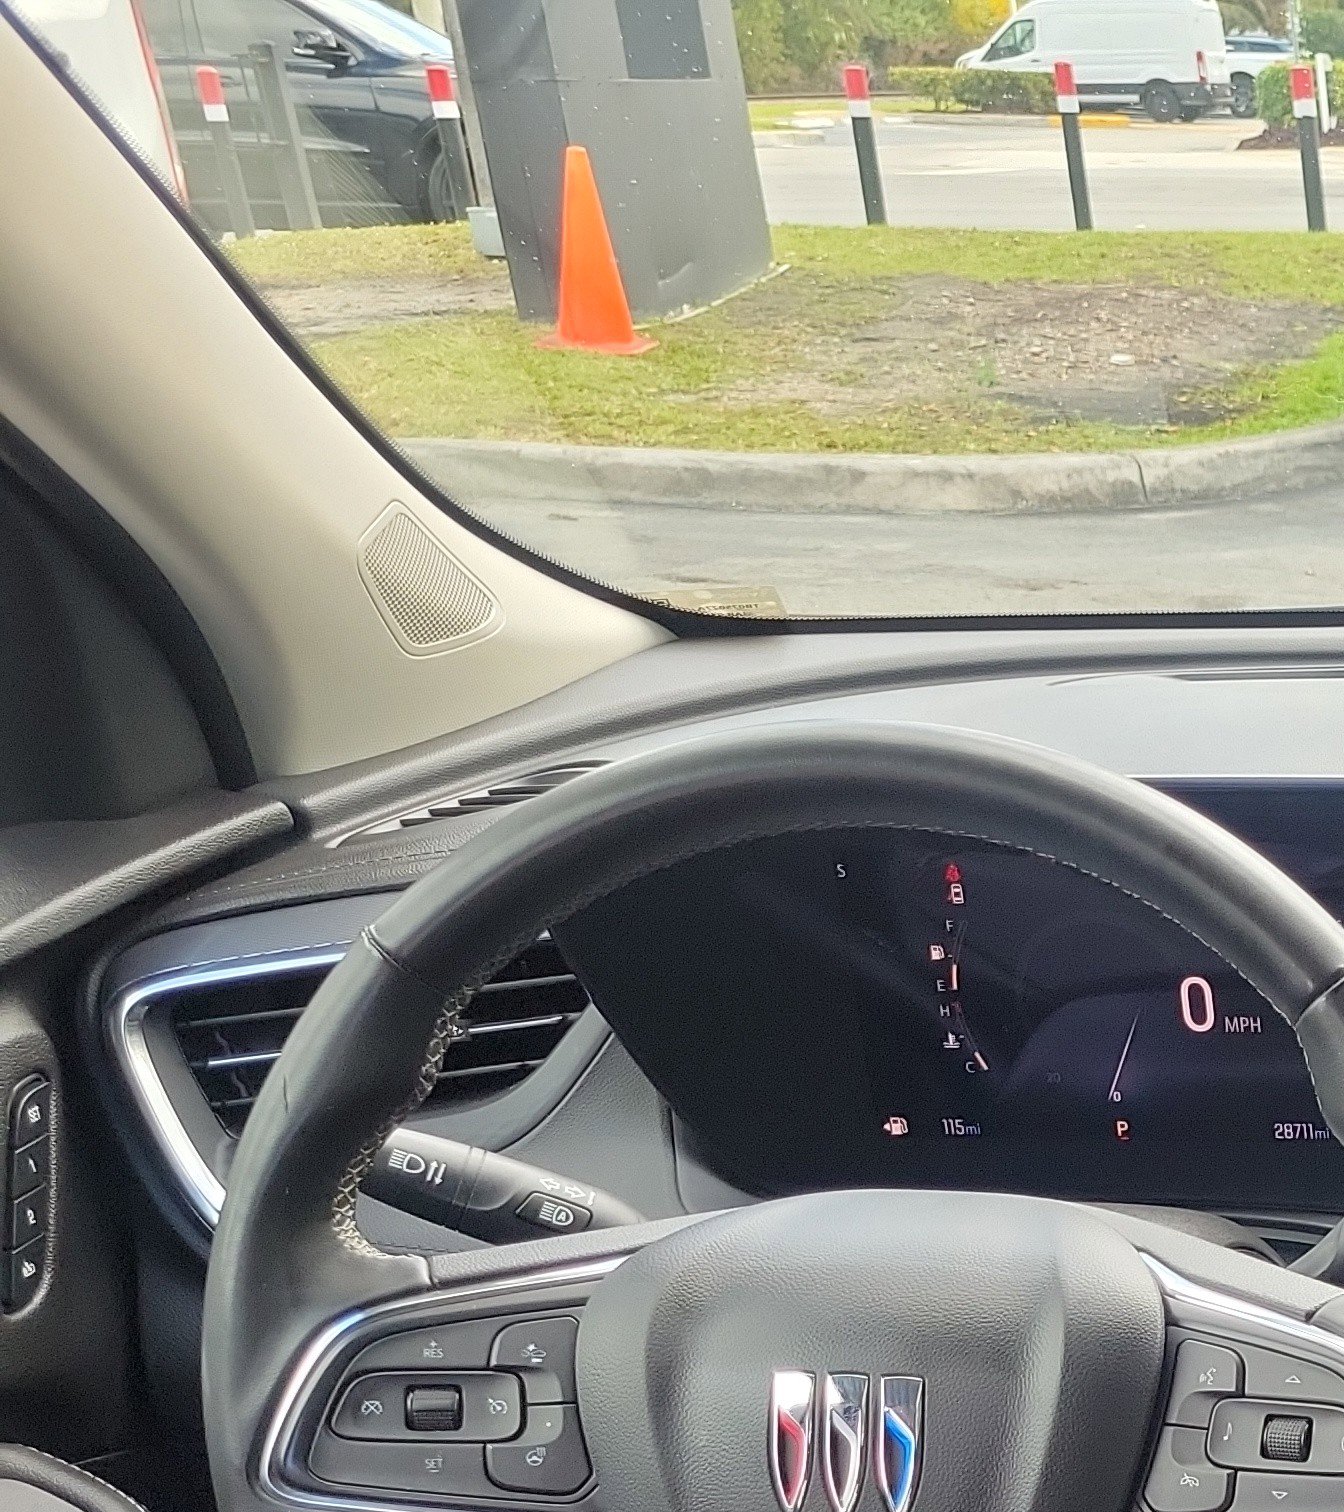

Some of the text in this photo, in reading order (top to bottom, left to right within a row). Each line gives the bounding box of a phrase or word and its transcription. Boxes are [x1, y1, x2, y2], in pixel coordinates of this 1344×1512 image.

[945, 919, 954, 932] F
[936, 980, 946, 992] E
[939, 1004, 950, 1017] H
[1180, 976, 1262, 1033] 0 MPH
[965, 1061, 976, 1074] C
[1113, 1091, 1122, 1102] 0
[1116, 1120, 1129, 1137] P
[423, 1348, 444, 1358] RES
[425, 1458, 443, 1469] SET
